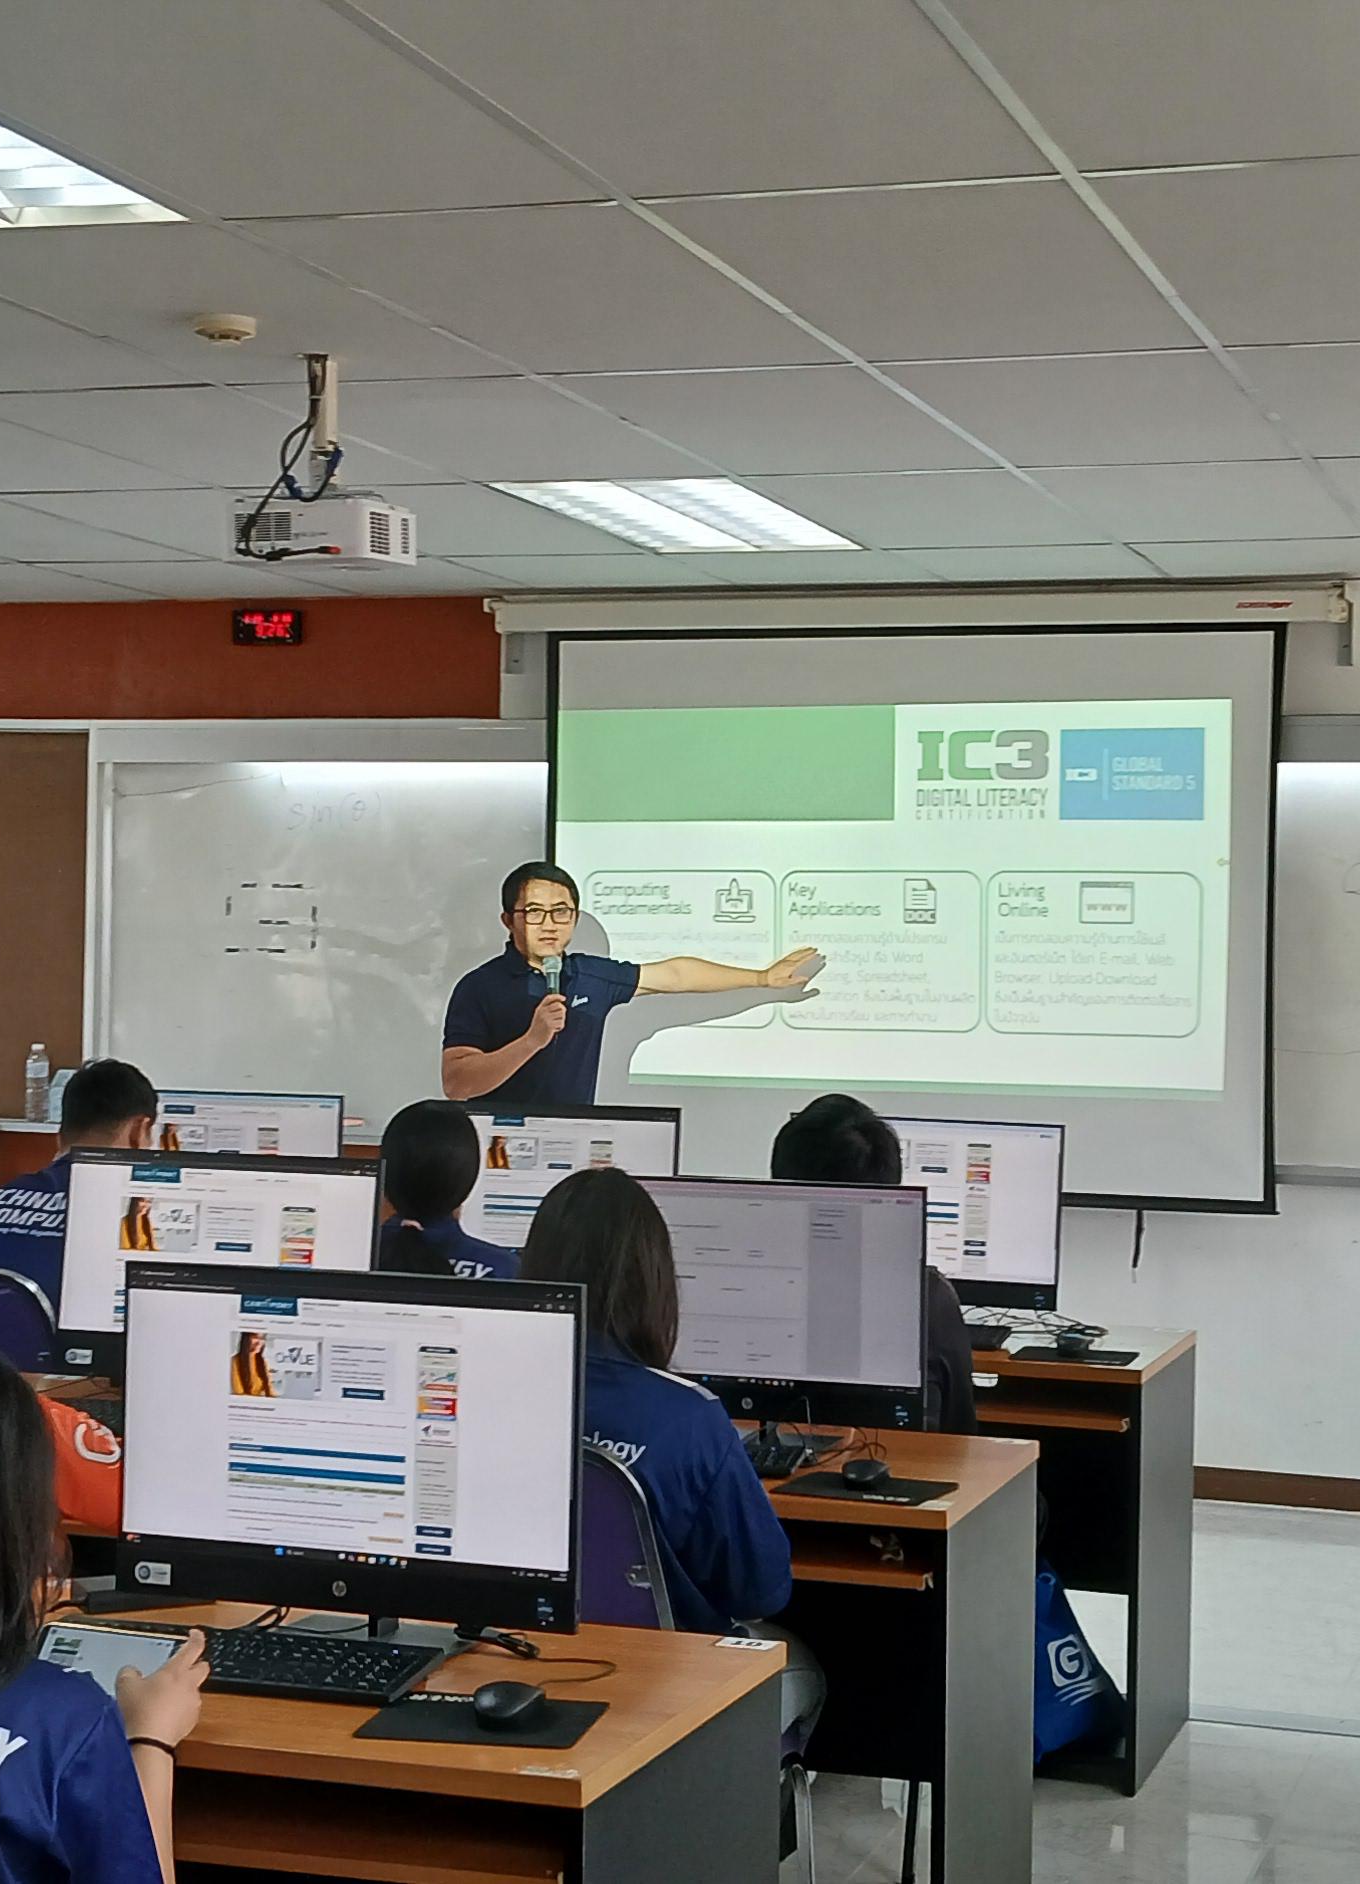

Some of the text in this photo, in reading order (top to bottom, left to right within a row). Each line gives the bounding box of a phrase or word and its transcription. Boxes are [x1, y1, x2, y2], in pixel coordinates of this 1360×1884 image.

[917, 730, 1050, 781] IC3
[916, 788, 1049, 807] DIGITAL LITERACY
[593, 882, 671, 899] Computing
[789, 882, 817, 900] Key
[998, 883, 1045, 901] Living
[593, 901, 692, 915] Fundamentals
[789, 902, 881, 919] Applications
[998, 903, 1049, 917] Online
